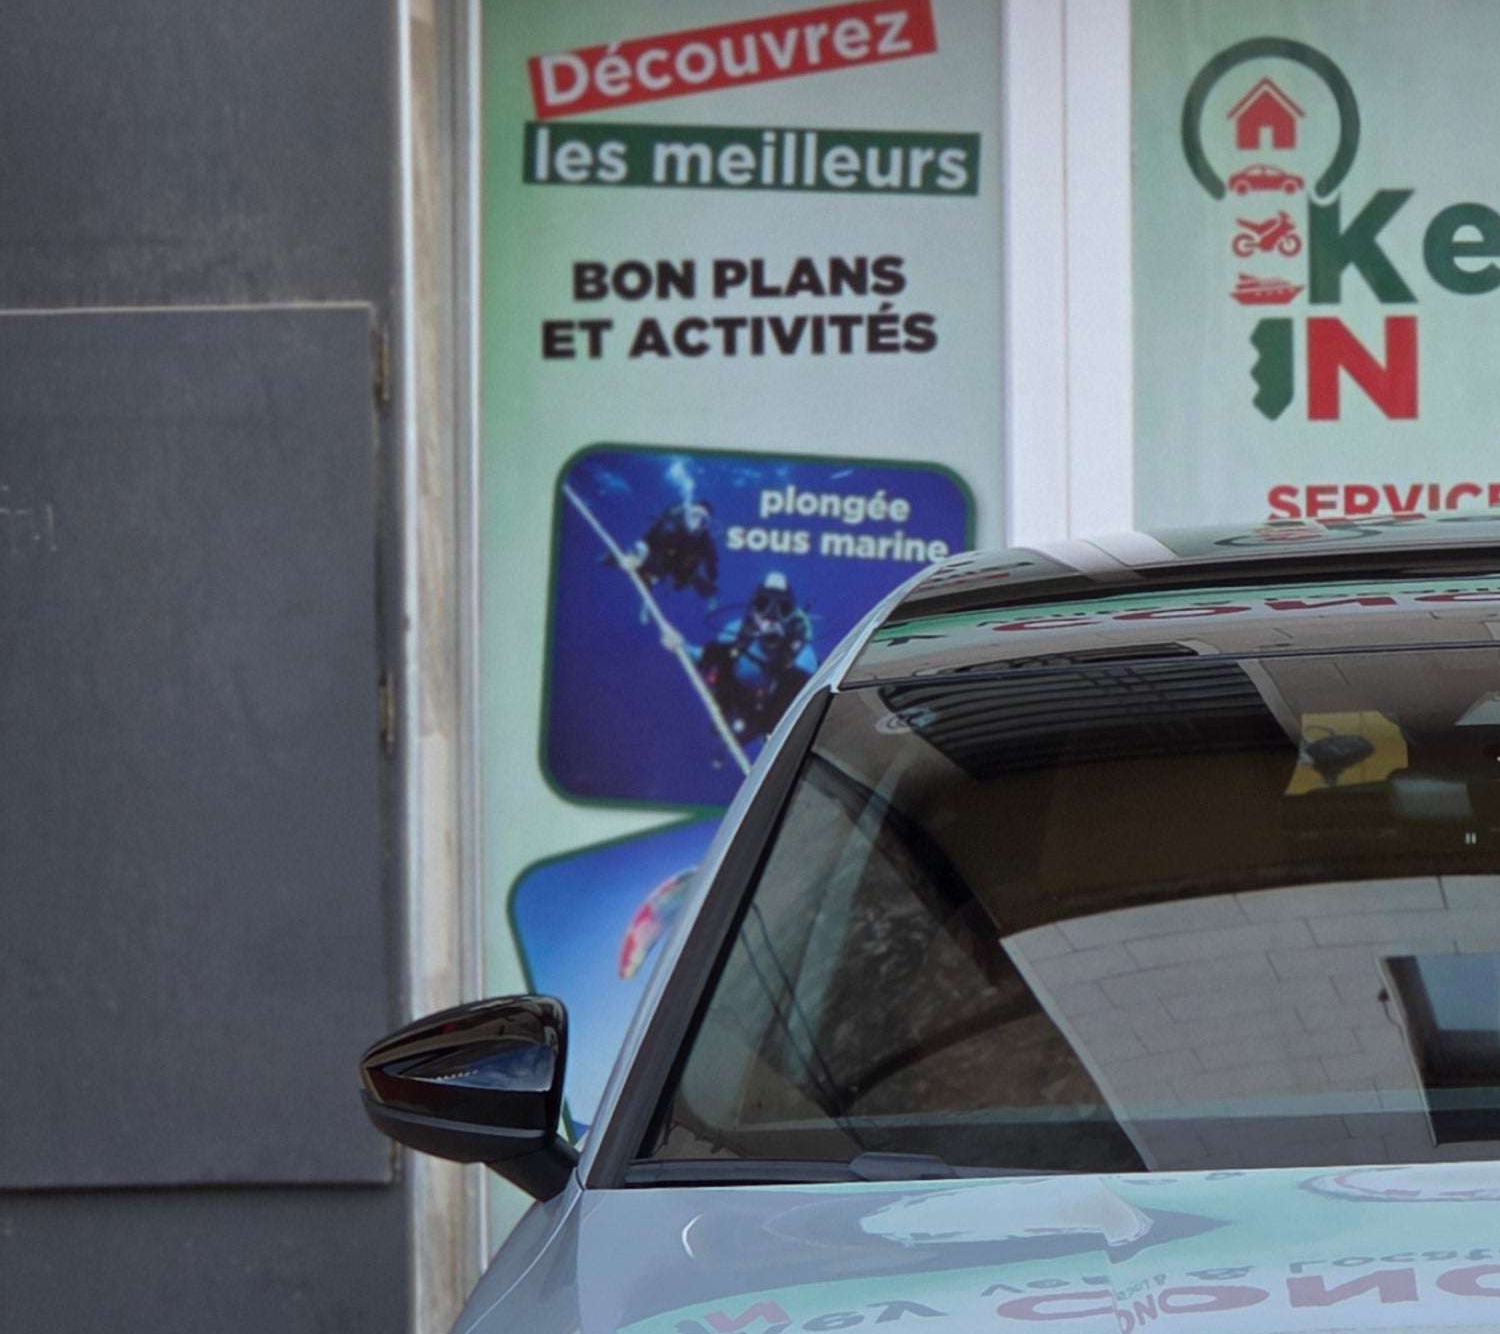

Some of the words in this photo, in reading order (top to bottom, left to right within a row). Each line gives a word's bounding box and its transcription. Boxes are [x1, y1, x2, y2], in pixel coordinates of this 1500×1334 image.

[543, 9, 911, 107] Découvrez
[534, 128, 627, 183] les
[652, 133, 969, 191] meilleurs
[572, 261, 695, 301] BON
[714, 257, 906, 298] PLANS
[542, 320, 613, 359] ET
[630, 304, 938, 358] ACTIVITÉS
[759, 484, 911, 524] plongée
[725, 525, 811, 554] sous
[820, 530, 950, 563] marine
